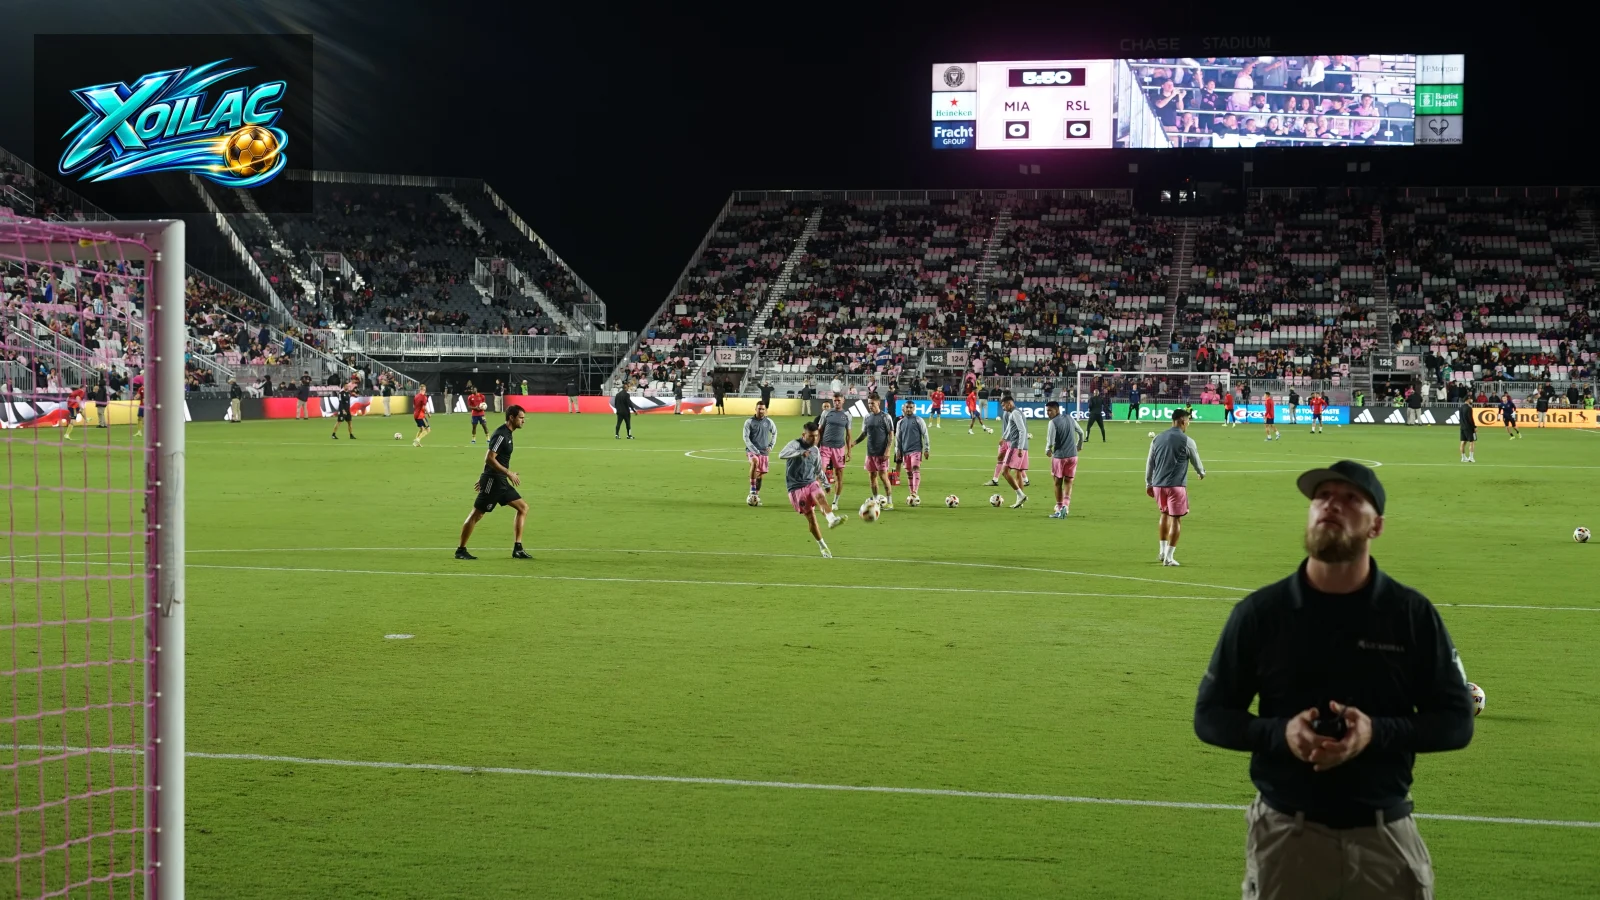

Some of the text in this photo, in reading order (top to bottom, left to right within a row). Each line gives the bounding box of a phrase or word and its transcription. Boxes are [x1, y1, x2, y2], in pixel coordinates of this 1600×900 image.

[1120, 36, 1271, 50] CHASE STADIUM
[1022, 71, 1072, 85] 5:50
[1004, 101, 1030, 112] MIA
[1066, 100, 1090, 111] RSL
[934, 126, 974, 138] Fracht
[1008, 123, 1027, 137] 0
[1069, 123, 1088, 136] 0
[931, 355, 943, 363] 123
[951, 355, 964, 363] 124
[1150, 357, 1163, 365] 124
[1379, 358, 1392, 366] 125
[1401, 359, 1415, 367] 126
